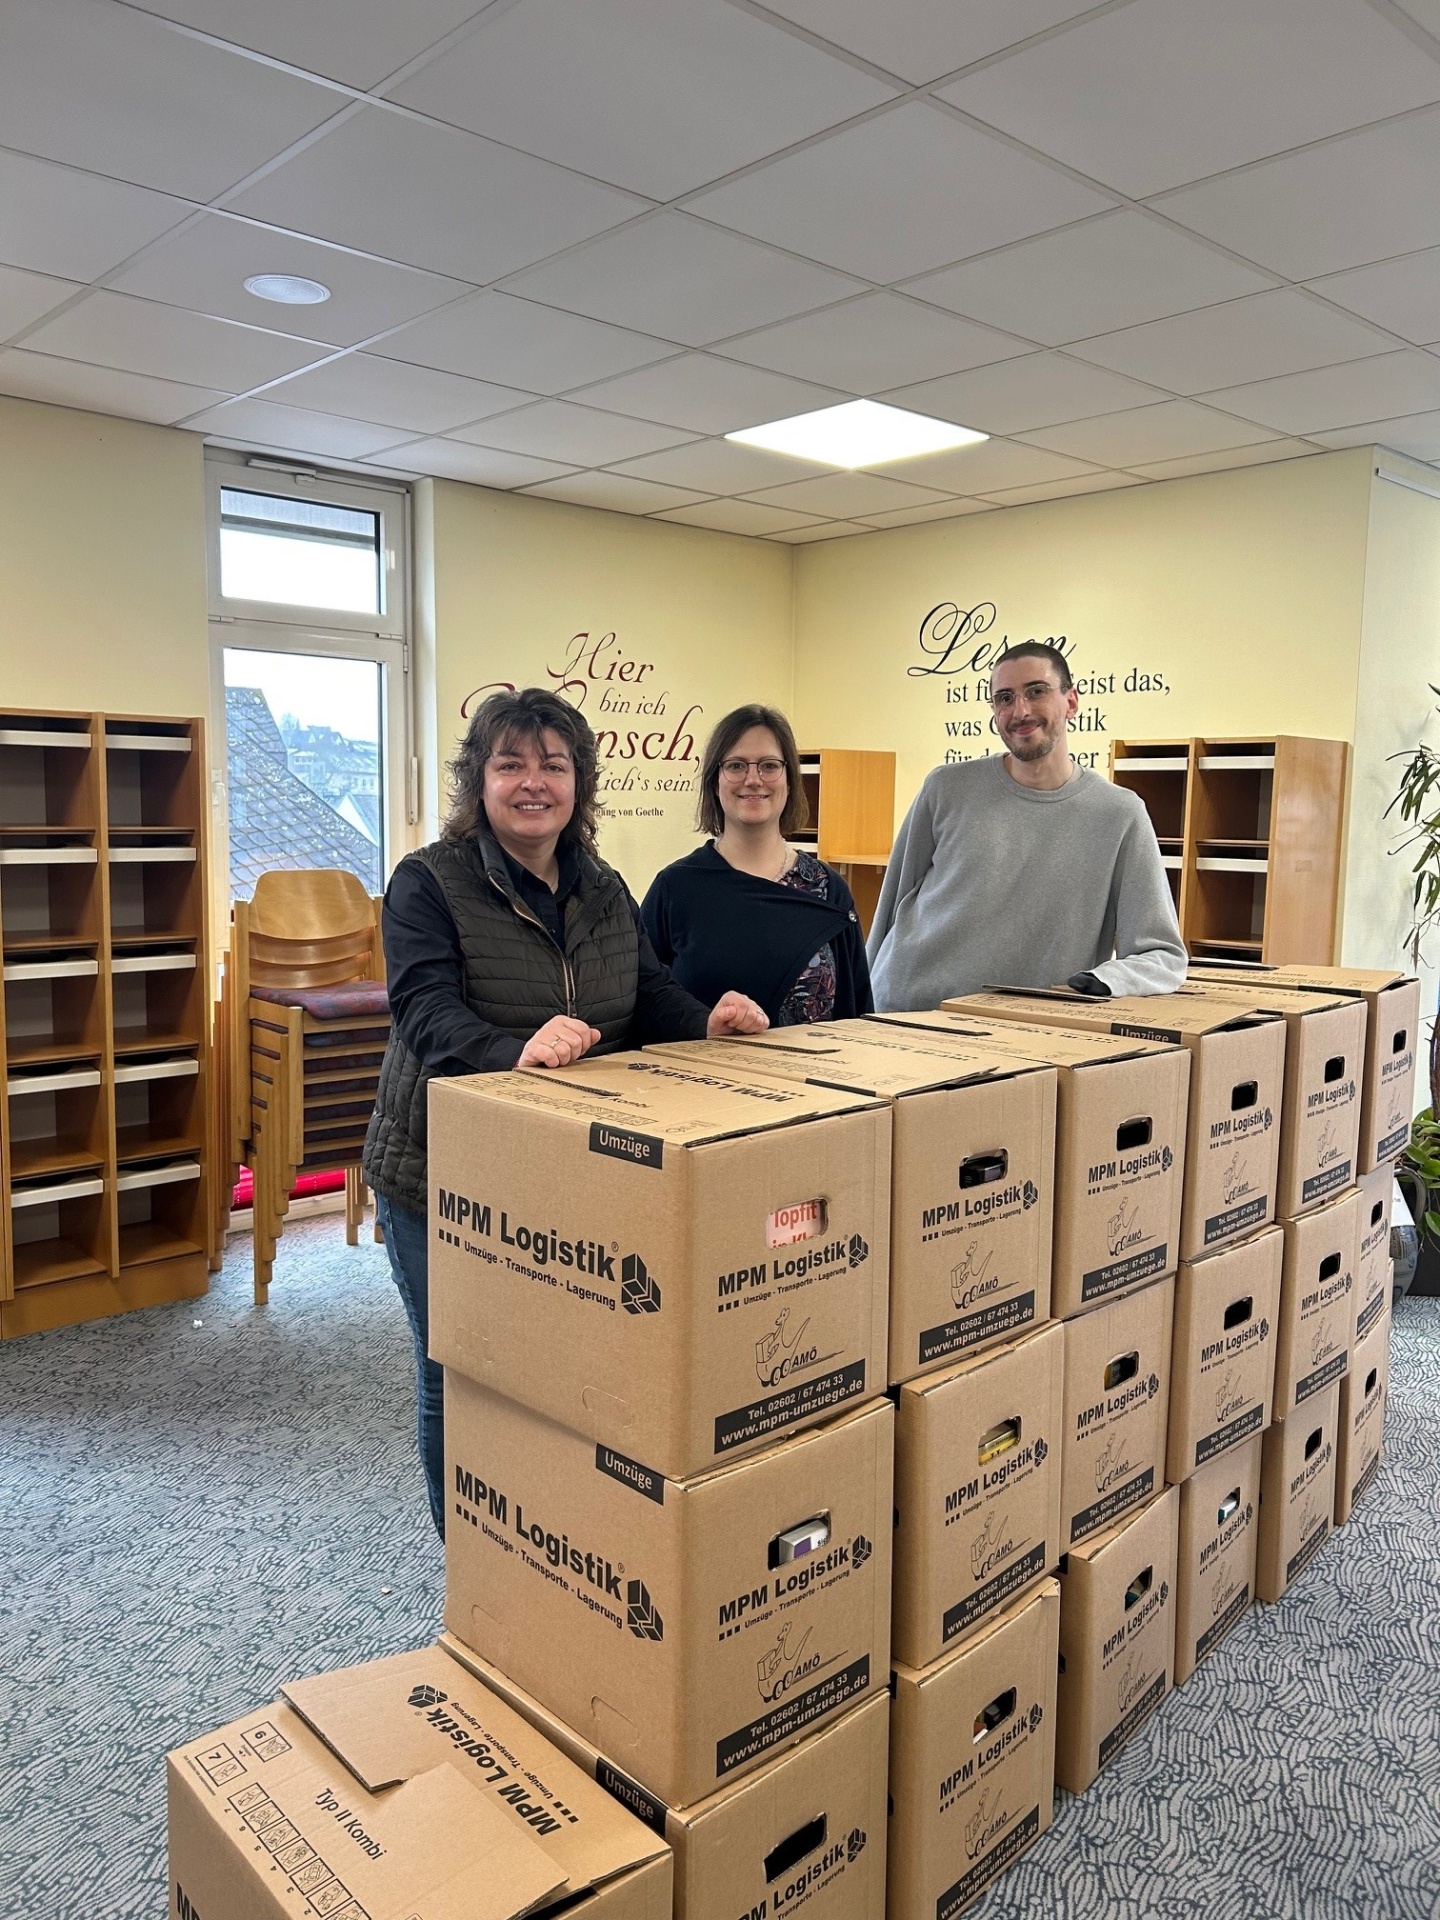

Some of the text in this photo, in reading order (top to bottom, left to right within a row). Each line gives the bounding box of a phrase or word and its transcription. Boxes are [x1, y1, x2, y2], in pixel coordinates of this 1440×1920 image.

[547, 632, 653, 683] Hier
[908, 602, 1076, 676] Lesn
[600, 688, 669, 716] bin ich
[947, 680, 967, 703] ist
[1124, 668, 1170, 695] das,
[945, 718, 981, 737] was
[654, 774, 694, 792] sein.
[636, 808, 664, 816] Goethe
[1308, 1086, 1349, 1108] MPM Logistik
[600, 1130, 650, 1158] Umzüge
[1211, 1120, 1231, 1138] MPM
[1233, 1110, 1263, 1132] Logistik
[1089, 1150, 1161, 1183] MPM Logistik
[439, 1187, 491, 1237] MPM
[923, 1186, 1021, 1228] MPM Logistik
[464, 1241, 616, 1310] Umzüge Transporte Lagerung
[719, 1241, 847, 1296] MPM Logistik
[744, 1267, 847, 1305] Umzüge Transporte Lagerung
[979, 1276, 998, 1293] AMÖ
[1085, 1258, 1165, 1297] www.mpm-umzuege.de
[945, 1302, 1018, 1336] Tel. 02602 67 474 33
[1301, 1294, 1318, 1312] MPM
[1320, 1278, 1345, 1301] Logistik
[792, 1346, 817, 1367] AMÖ
[925, 1308, 1032, 1357] www.mpm-umzuege.de
[1202, 1340, 1223, 1362] MPM
[1226, 1324, 1259, 1350] Logistik
[722, 1379, 862, 1446] www.mpm-umzuege.de
[748, 1374, 844, 1420] Tel. 02602 67 474 33
[1077, 1380, 1148, 1429] MPM Logistik
[456, 1464, 507, 1525] MPM
[605, 1451, 652, 1490] Umzüge
[946, 1447, 1034, 1513] MPM Logistik
[1290, 1472, 1305, 1495] MPM
[1306, 1450, 1326, 1479] Logistik
[995, 1540, 1013, 1559] AMÖ
[1200, 1538, 1217, 1566] MPM
[1220, 1510, 1245, 1545] Logistik
[482, 1522, 623, 1629] Umzüge Transporte Lagerung
[719, 1546, 849, 1626] MPM Logistik
[745, 1569, 850, 1628] Umzüge Transporte Lagerung
[947, 1558, 1043, 1635] www.mpm-umzuege.de
[966, 1599, 977, 1610] Tel.
[1002, 1573, 1010, 1583] 67
[1023, 1557, 1031, 1568] 33
[1103, 1625, 1125, 1659] MPM
[1127, 1591, 1159, 1634] Logistik
[794, 1652, 821, 1679] AMÖ
[724, 1674, 867, 1767] www.mpm-umzuege.de
[751, 1673, 848, 1738] Tel. 02602 67 474 33
[208, 1752, 222, 1761] 7
[255, 1730, 267, 1739] 6
[451, 1702, 553, 1799] Umzüge Transporte Lagerung
[940, 1715, 1027, 1800] MPM Logistik
[497, 1782, 562, 1836] MPM
[605, 1769, 654, 1819] Umzüge
[315, 1788, 339, 1811] Typ
[343, 1819, 387, 1860] Kombi
[774, 1843, 845, 1911] Logistik
[777, 1891, 812, 1920] Transporte
[817, 1865, 845, 1890] Lagerung
